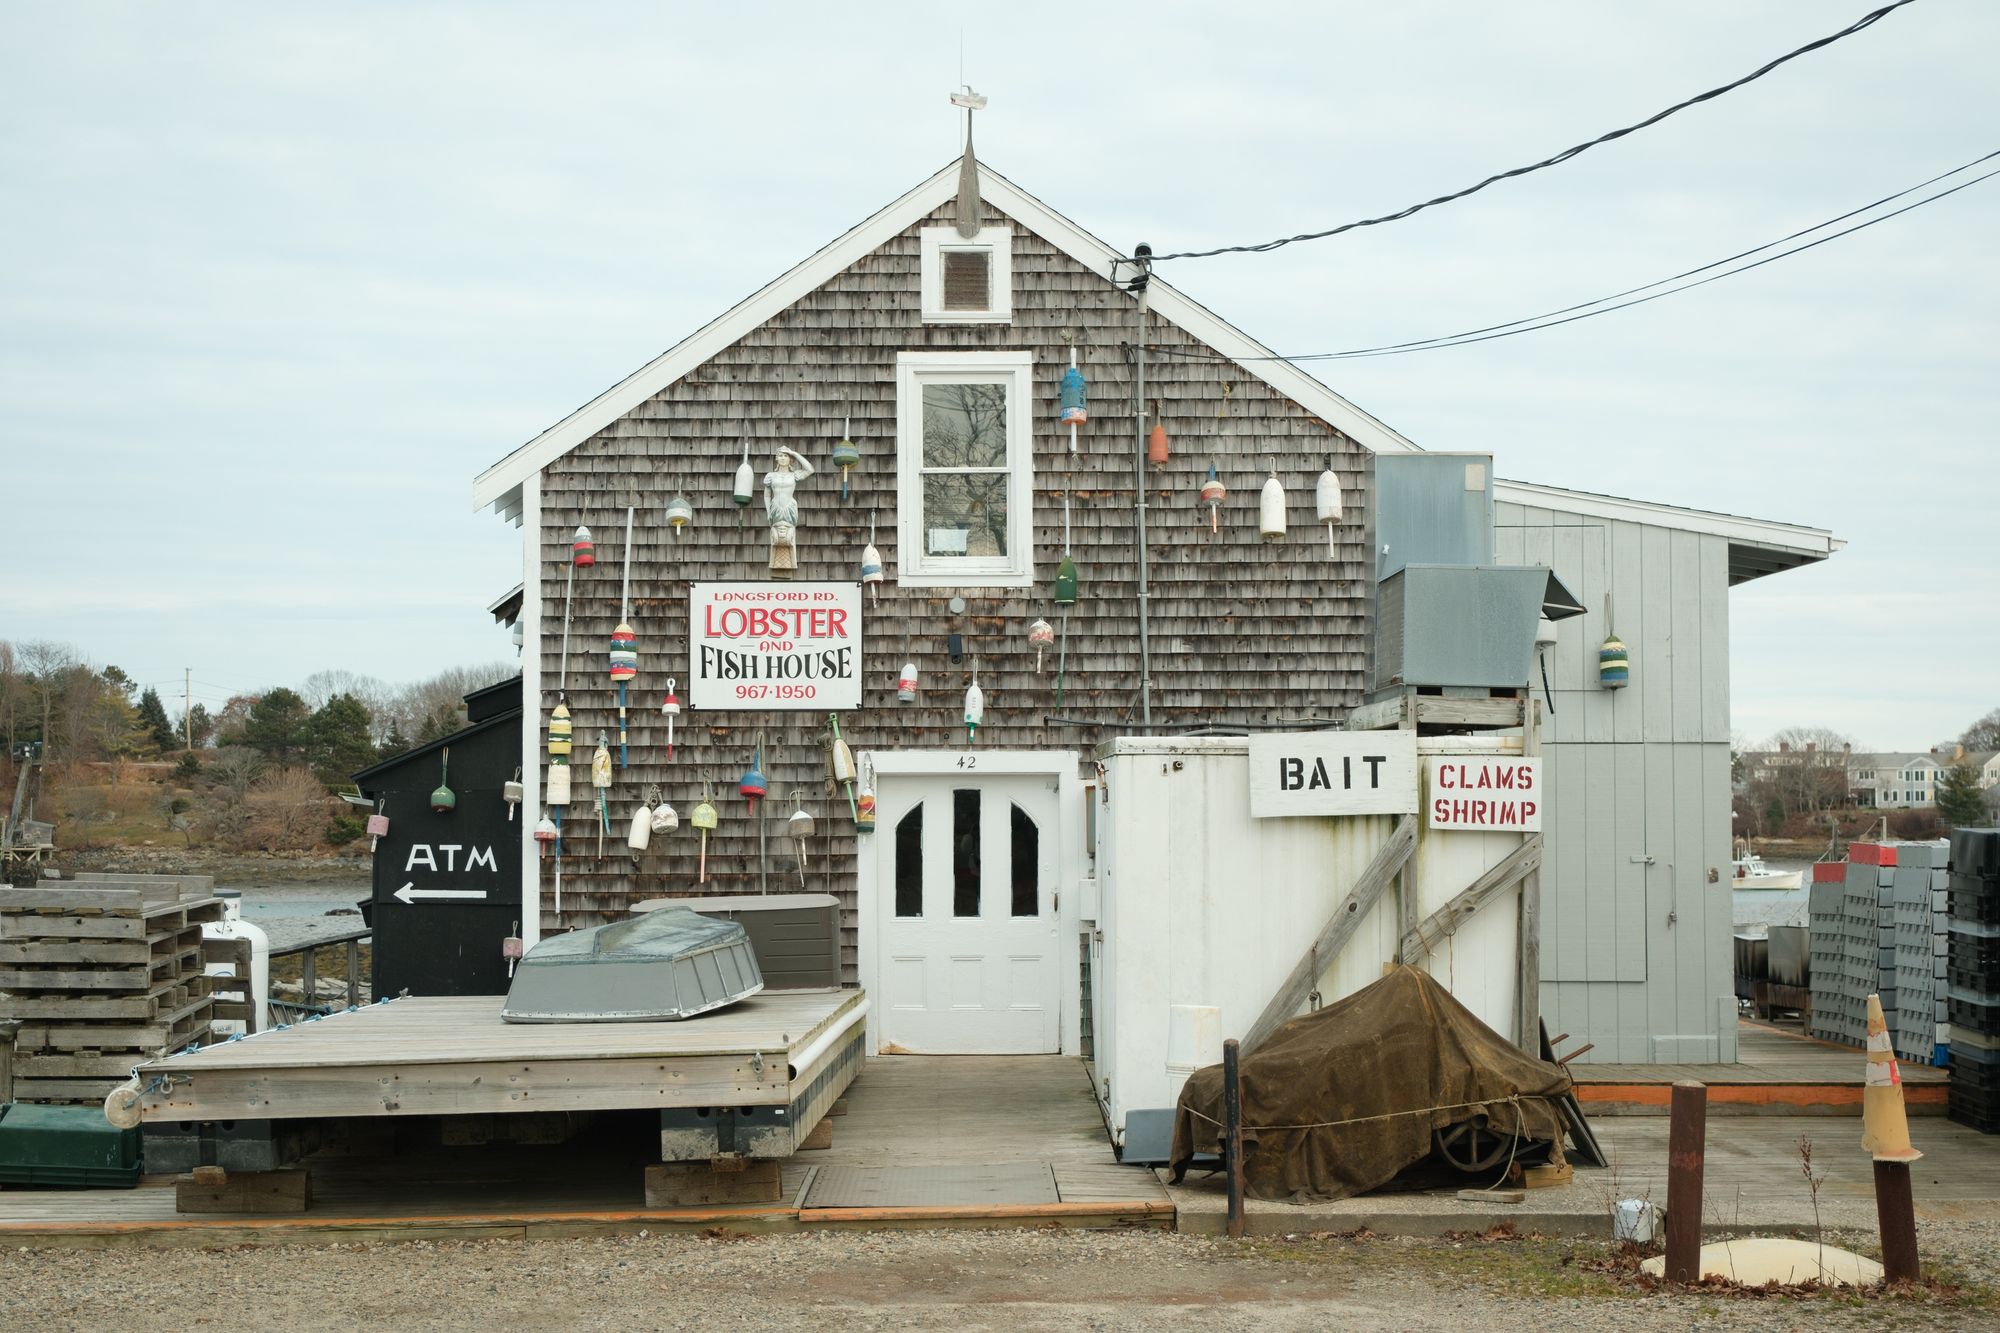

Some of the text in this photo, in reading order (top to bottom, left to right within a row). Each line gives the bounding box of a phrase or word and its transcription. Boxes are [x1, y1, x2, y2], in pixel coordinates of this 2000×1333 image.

[714, 592, 838, 602] LANGSFORD RD.
[704, 604, 848, 639] LOBSTER
[759, 640, 793, 652] AND
[700, 644, 852, 680] FISH HOUSE
[956, 755, 976, 769] 42
[1279, 755, 1387, 791] BAIT
[1439, 764, 1533, 790] CLAMS
[1434, 798, 1537, 826] SHRIMP
[404, 843, 499, 873] ATM
